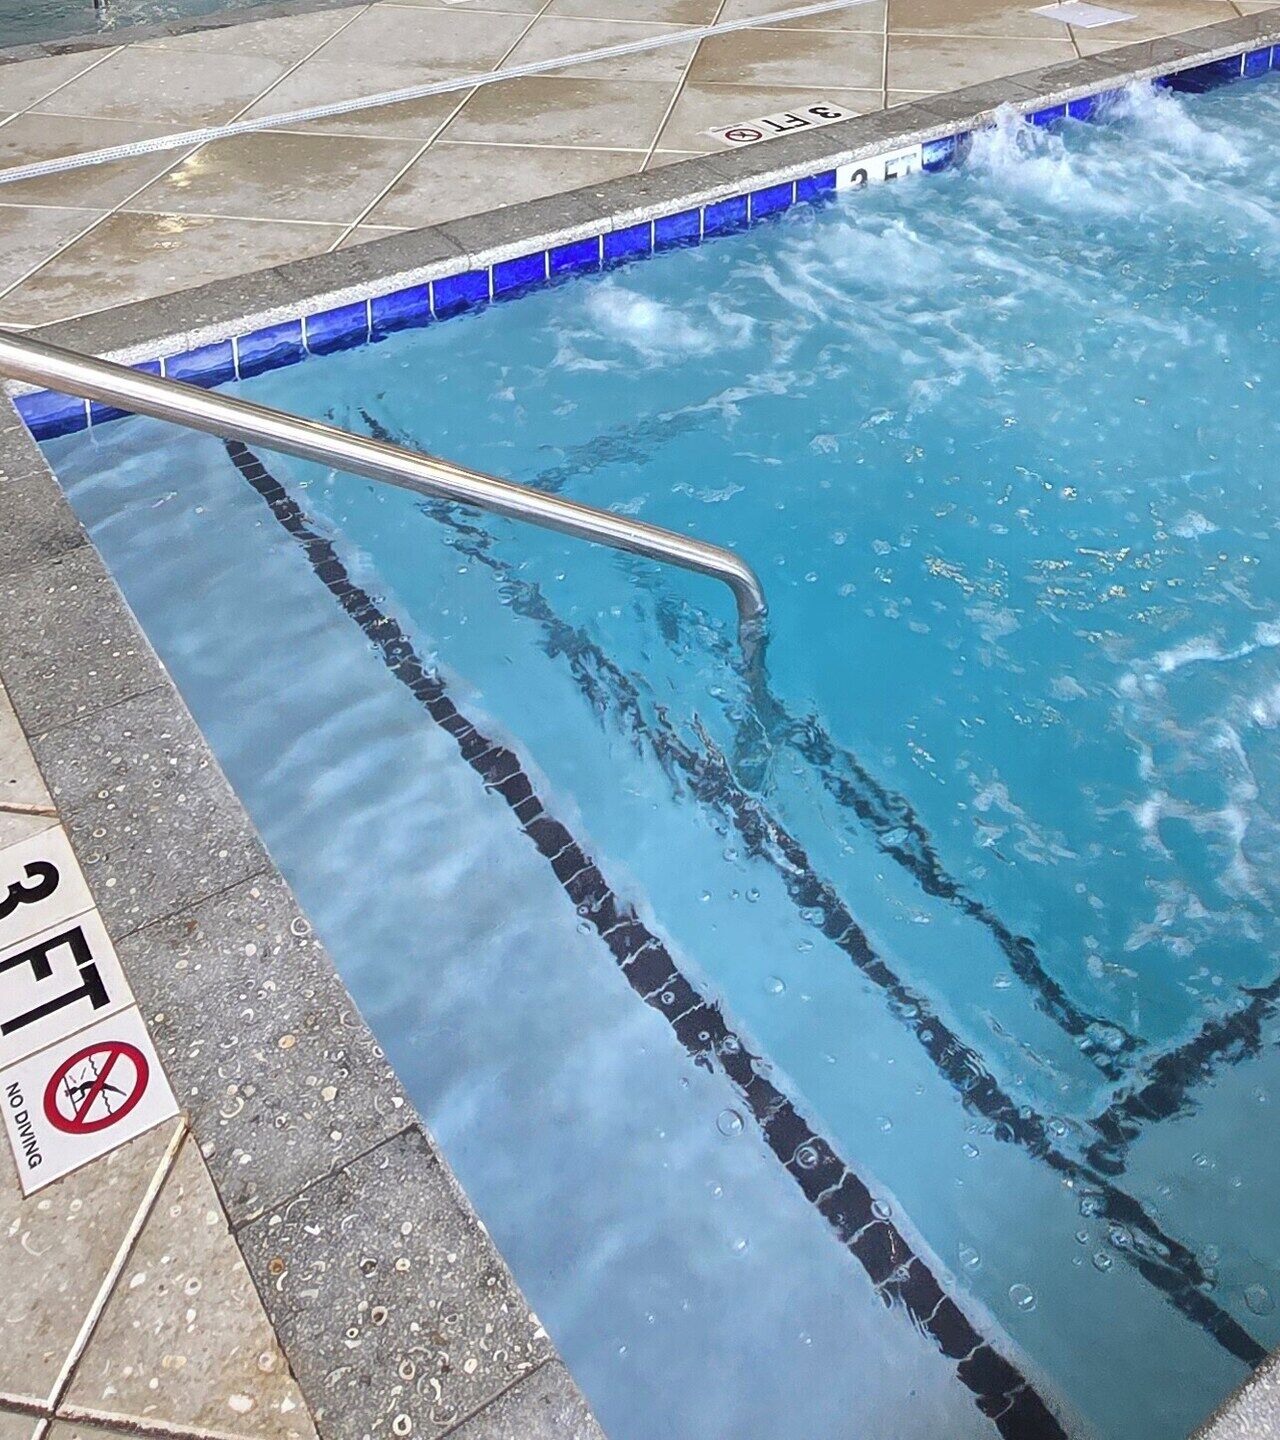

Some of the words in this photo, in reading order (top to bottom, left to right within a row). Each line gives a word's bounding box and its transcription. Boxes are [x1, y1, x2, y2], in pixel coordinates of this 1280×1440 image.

[762, 113, 812, 132] FT
[808, 106, 842, 119] 3
[5, 1081, 24, 1109] NO
[14, 1109, 43, 1170] DIVING
